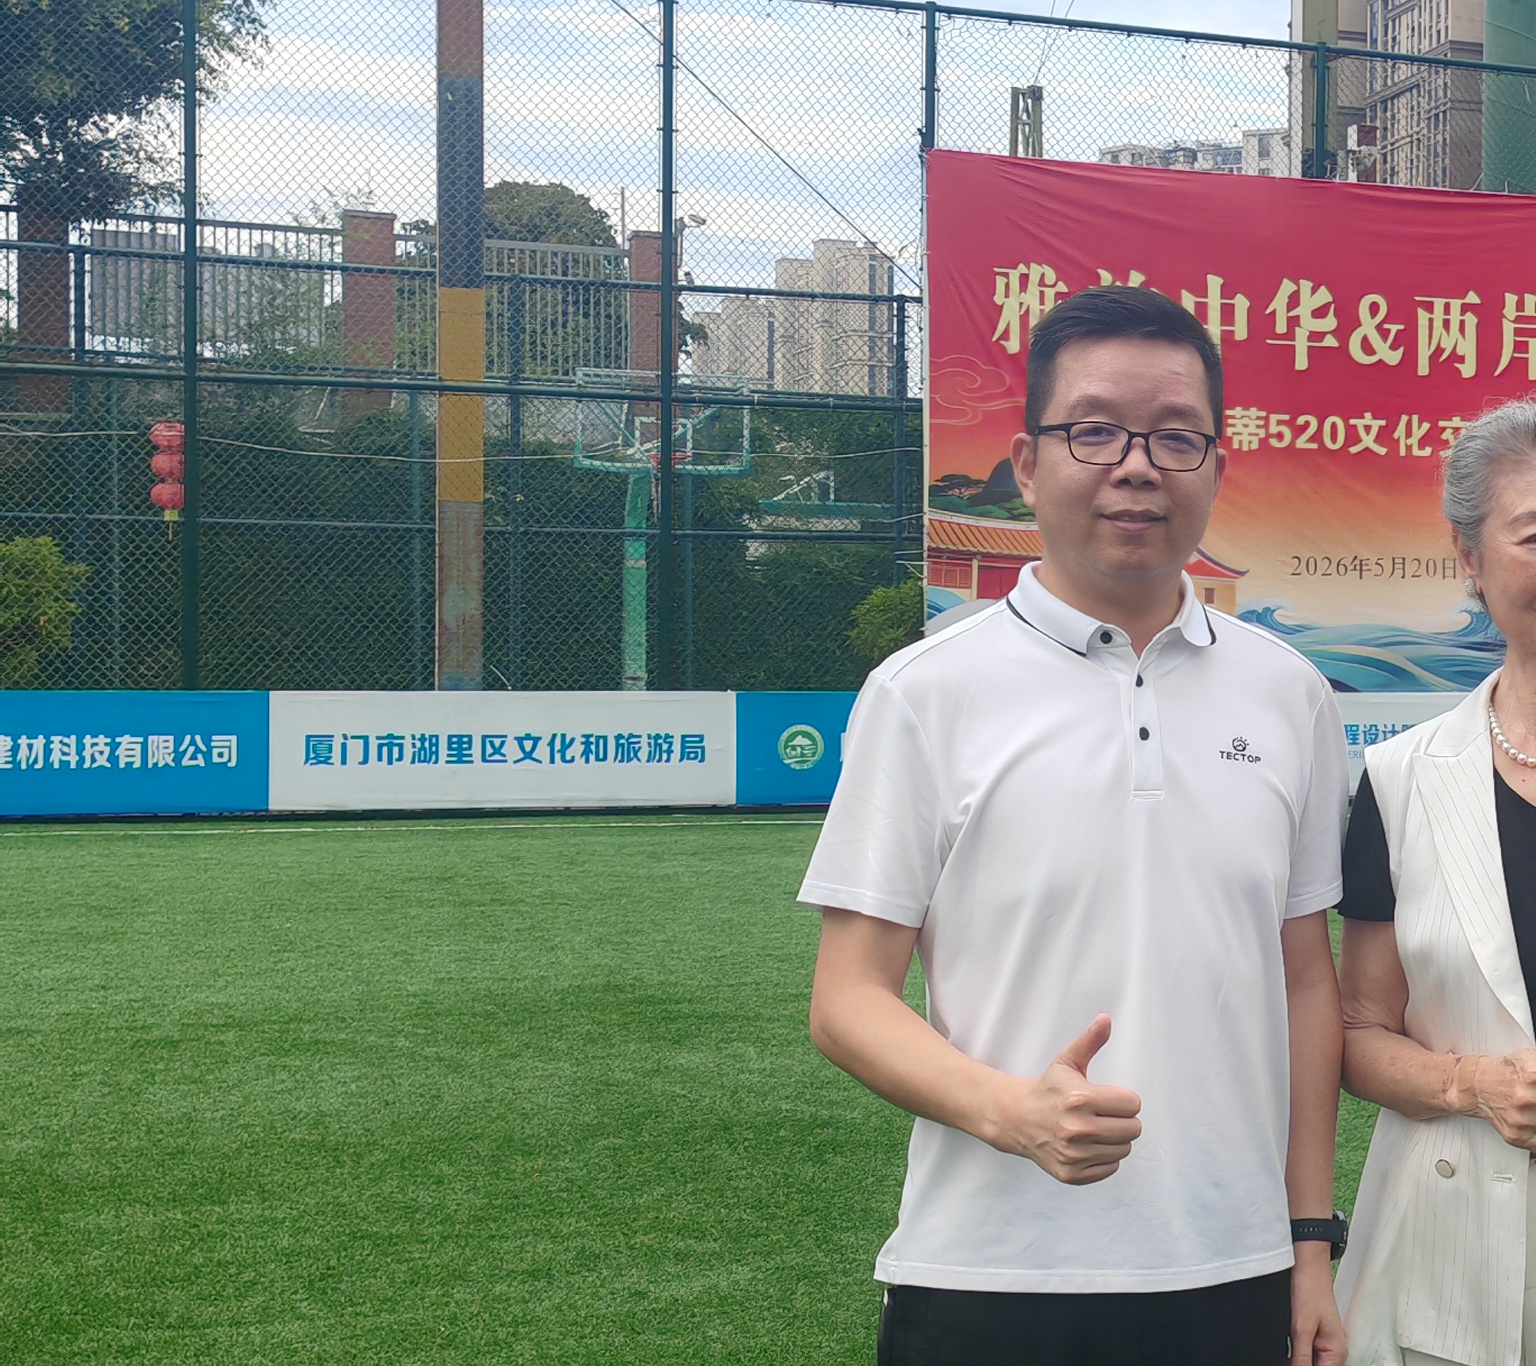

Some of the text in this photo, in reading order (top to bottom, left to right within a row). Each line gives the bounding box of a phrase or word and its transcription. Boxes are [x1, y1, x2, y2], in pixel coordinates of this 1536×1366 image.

[1290, 555, 1457, 580] 2026年5月20日
[303, 733, 706, 766] 厦门市湖里区文化和旅游局
[1219, 750, 1262, 764] TECTOP
